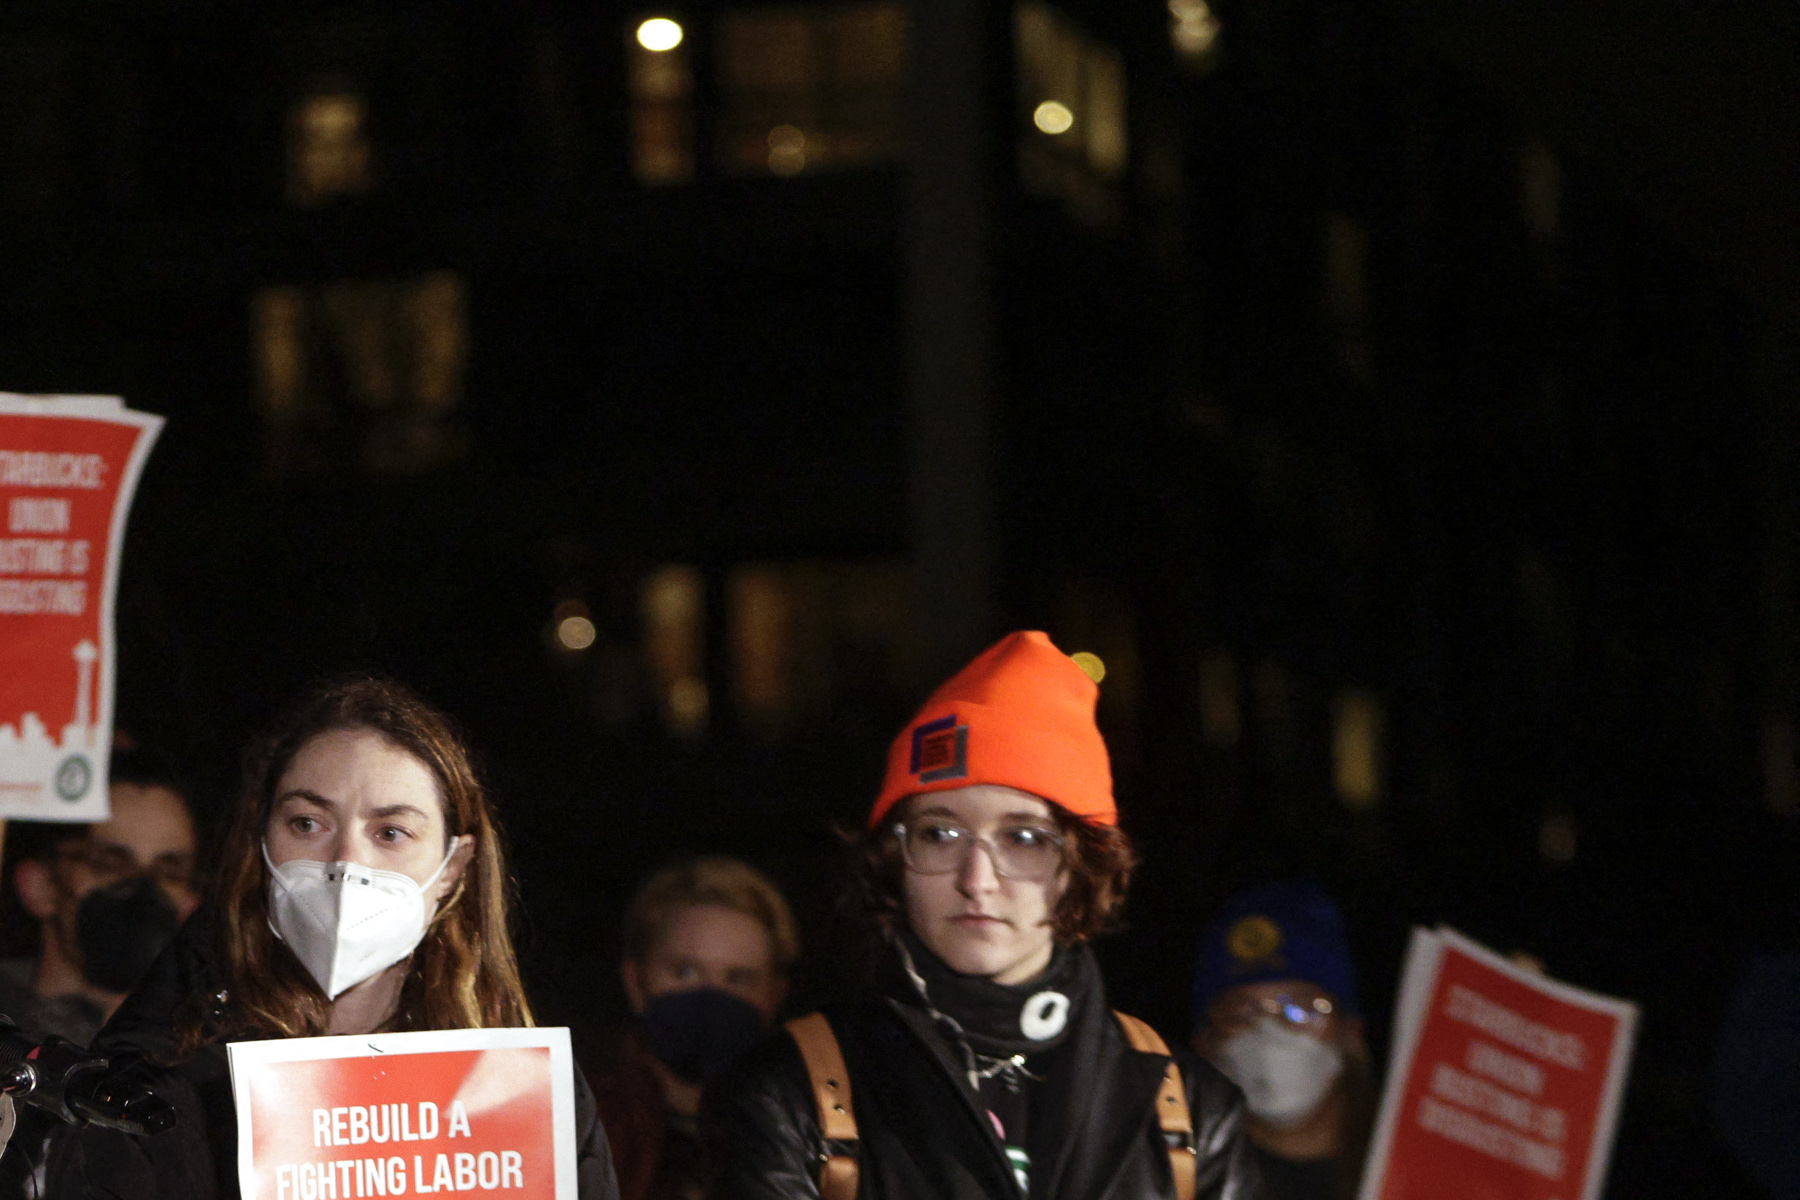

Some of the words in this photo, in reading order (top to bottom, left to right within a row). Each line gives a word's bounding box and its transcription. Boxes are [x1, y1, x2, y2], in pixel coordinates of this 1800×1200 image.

[312, 1100, 439, 1147] REBUILD
[447, 1099, 472, 1138] A
[414, 1150, 524, 1193] LABOR
